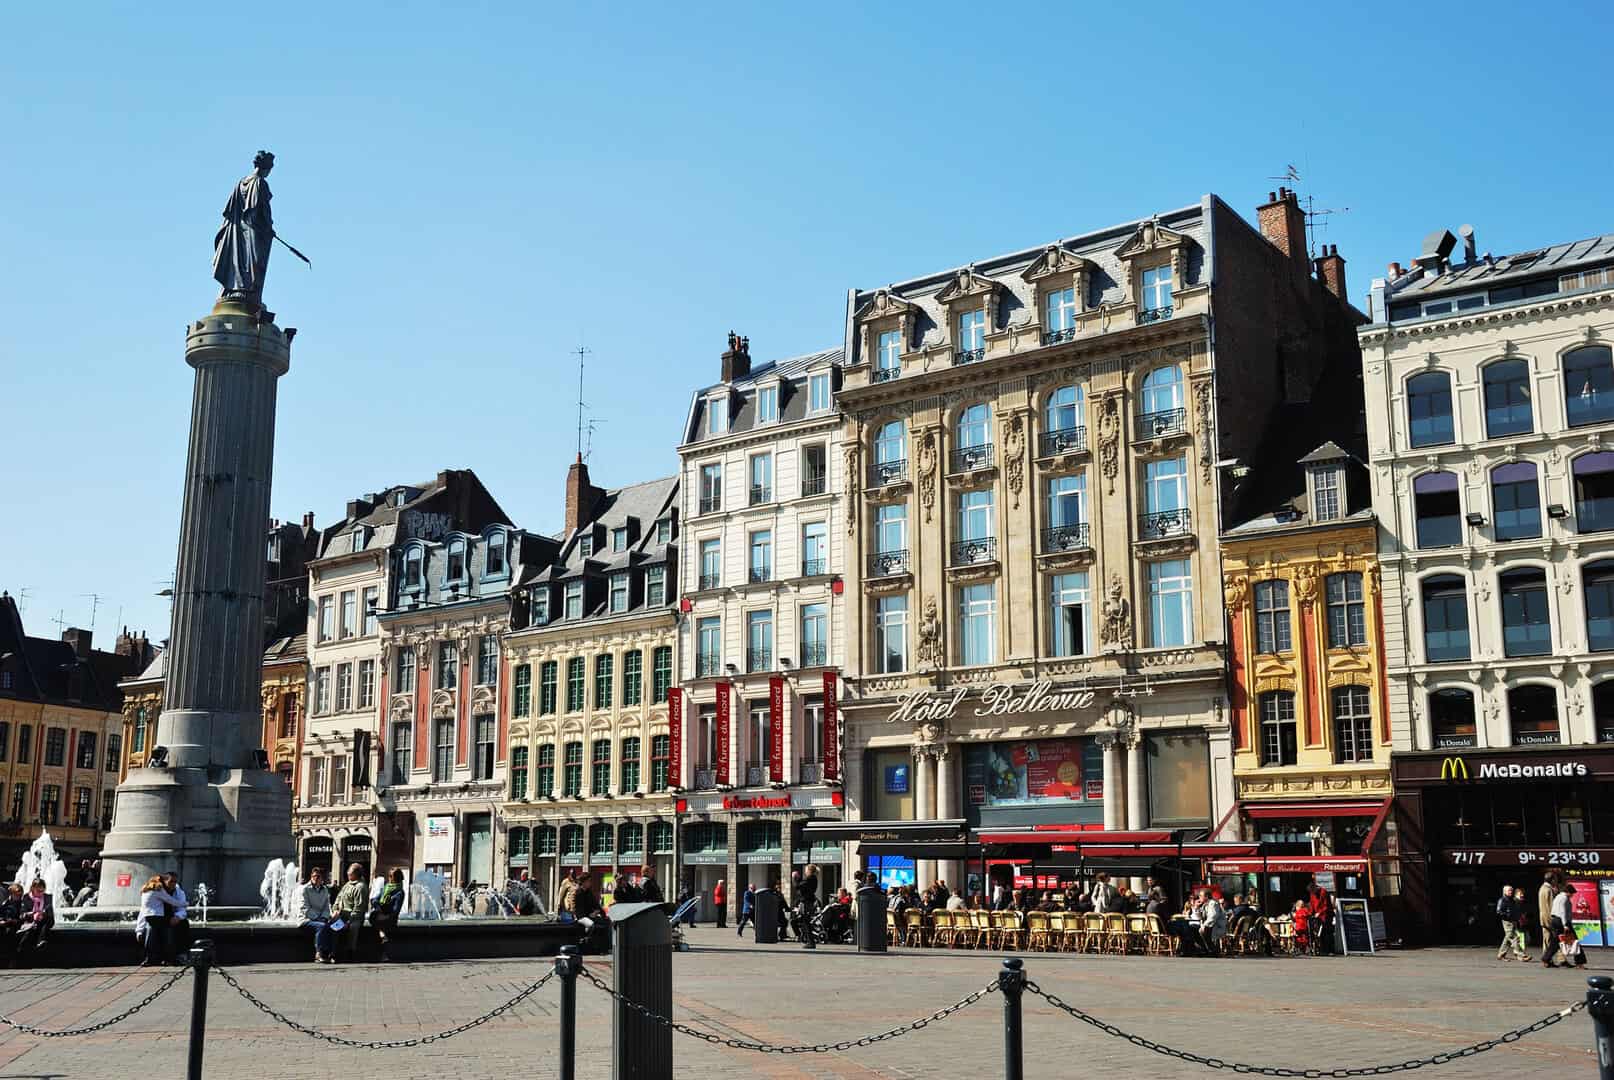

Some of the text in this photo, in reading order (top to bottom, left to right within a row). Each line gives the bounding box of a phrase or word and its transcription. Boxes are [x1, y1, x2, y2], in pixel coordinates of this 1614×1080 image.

[887, 680, 1095, 722] Hôtel Bellevue
[774, 716, 781, 730] du
[828, 712, 835, 726] du
[672, 724, 679, 737] du
[720, 720, 727, 734] du
[719, 737, 727, 763] furet
[773, 734, 781, 760] furet
[827, 730, 836, 757] furet
[671, 740, 679, 766] furet
[671, 769, 678, 779] le
[719, 767, 727, 776] le
[1480, 762, 1587, 778] McDonald's
[1518, 852, 1536, 864] 9h
[1075, 868, 1095, 876] PUL
[1323, 863, 1361, 872] Restaurant
